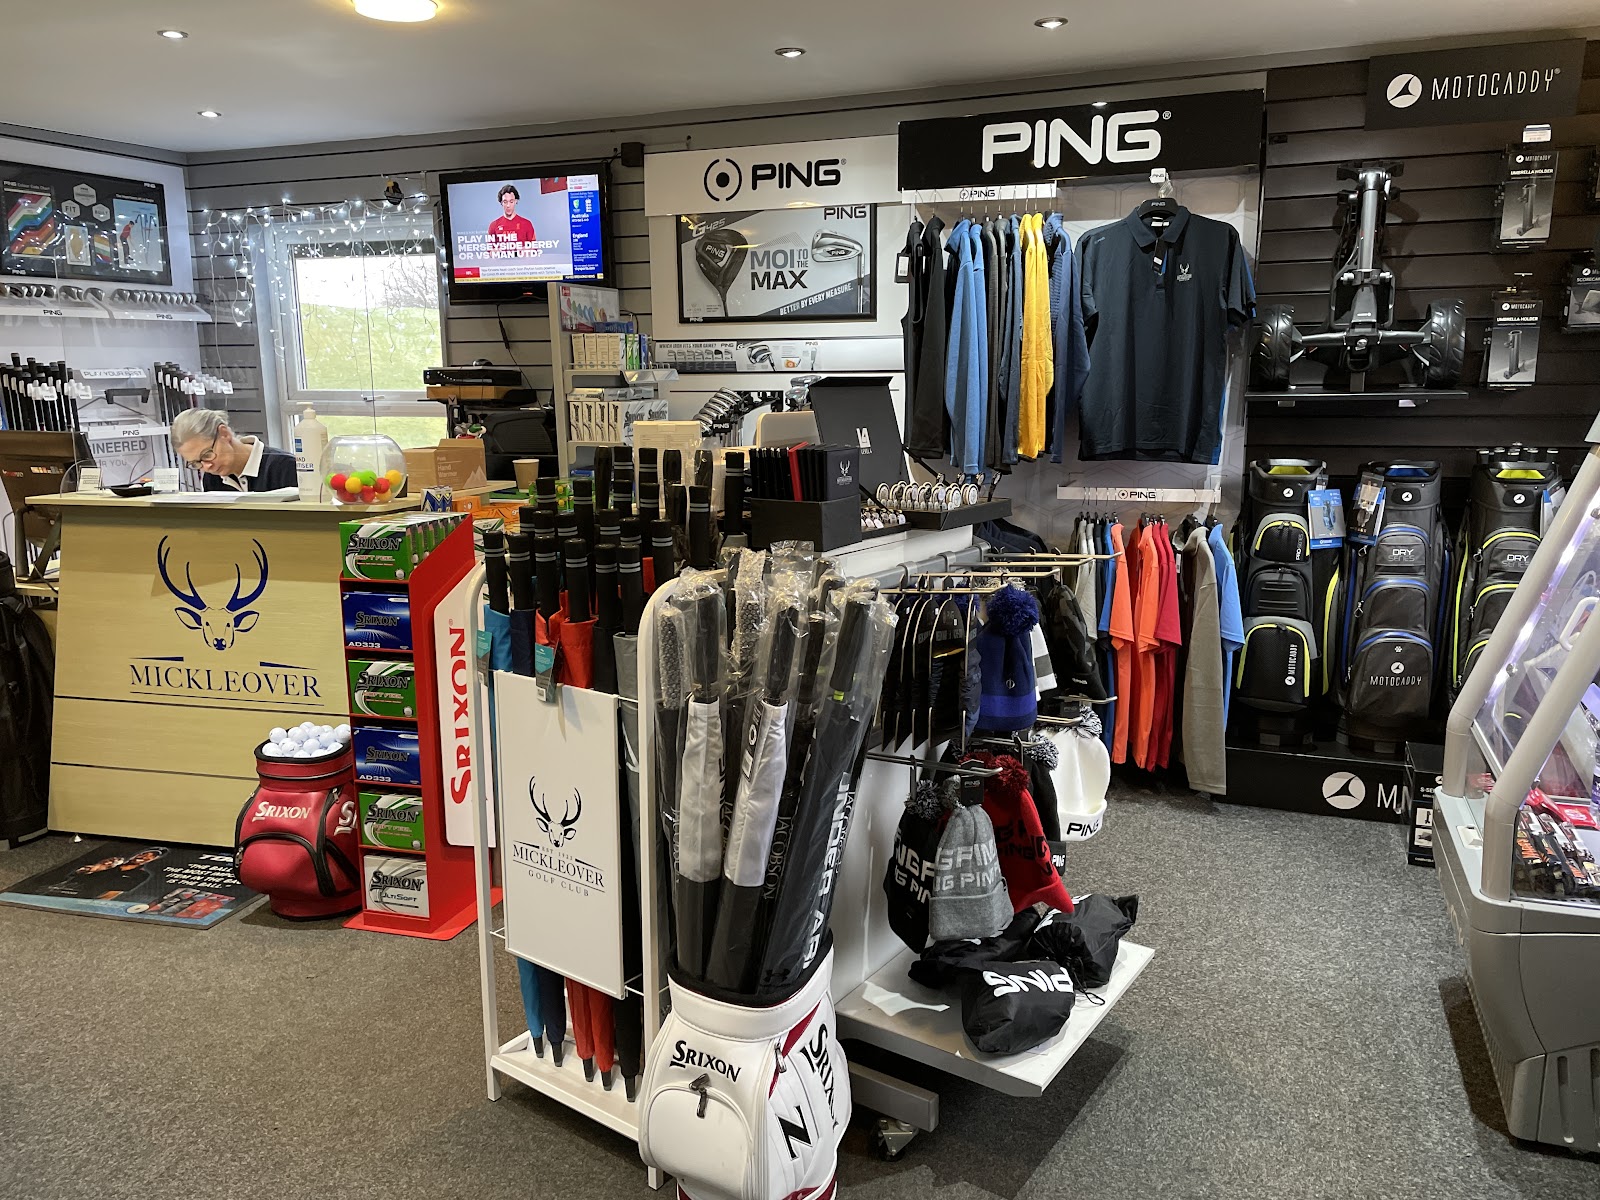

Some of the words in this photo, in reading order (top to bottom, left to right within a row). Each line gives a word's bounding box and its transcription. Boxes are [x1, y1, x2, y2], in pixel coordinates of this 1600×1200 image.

[1431, 68, 1554, 101] MOTOCADDY
[981, 109, 1162, 173] PING
[751, 158, 841, 191] PING
[969, 188, 996, 198] PING
[65, 205, 77, 213] FIT
[823, 205, 867, 221] PING
[457, 235, 483, 244] PLAY
[485, 234, 495, 242] IN
[496, 233, 518, 242] THE
[458, 241, 523, 252] MERSEYSIDE
[524, 240, 560, 249] DERBY
[458, 252, 474, 260] OR
[475, 251, 490, 260] VS
[491, 250, 516, 259] MAN
[516, 249, 543, 258] UTD?
[705, 243, 725, 259] PING
[750, 249, 795, 270] MOI
[796, 248, 809, 260] TO
[796, 259, 809, 268] THE
[750, 269, 808, 291] MAX
[779, 300, 801, 316] BETTER
[800, 298, 809, 308] BY
[808, 292, 826, 306] EVERY
[712, 422, 730, 430] PING
[91, 439, 148, 455] INEERED
[110, 459, 127, 467] YOU
[1129, 490, 1156, 500] PING
[347, 532, 400, 551] SRIXON
[1392, 548, 1414, 557] DRY
[1506, 553, 1530, 562] DRY
[355, 612, 399, 627] SRIXON
[347, 641, 381, 649] AD333
[1287, 643, 1297, 677] MOTOCADDY
[129, 663, 322, 699] MICKLEOVER
[357, 671, 410, 689] SRIXON
[1369, 675, 1422, 688] MOTOCADDY
[449, 627, 472, 804] SRIXON
[365, 746, 409, 762] SRIXON
[359, 774, 392, 782] AD333
[253, 801, 312, 821] SRIXON
[366, 804, 419, 823] SRIXON
[1065, 817, 1101, 837] PING
[512, 843, 605, 888] MICKLEOVER
[763, 815, 792, 900] JACOBSON
[1052, 854, 1066, 867] PING
[371, 870, 424, 892] SRIXON
[528, 869, 556, 884] GOLF
[560, 881, 589, 897] CLUB
[983, 966, 1074, 998] PING
[670, 1039, 742, 1083] SRIXON
[808, 1022, 840, 1130] SRIXON
